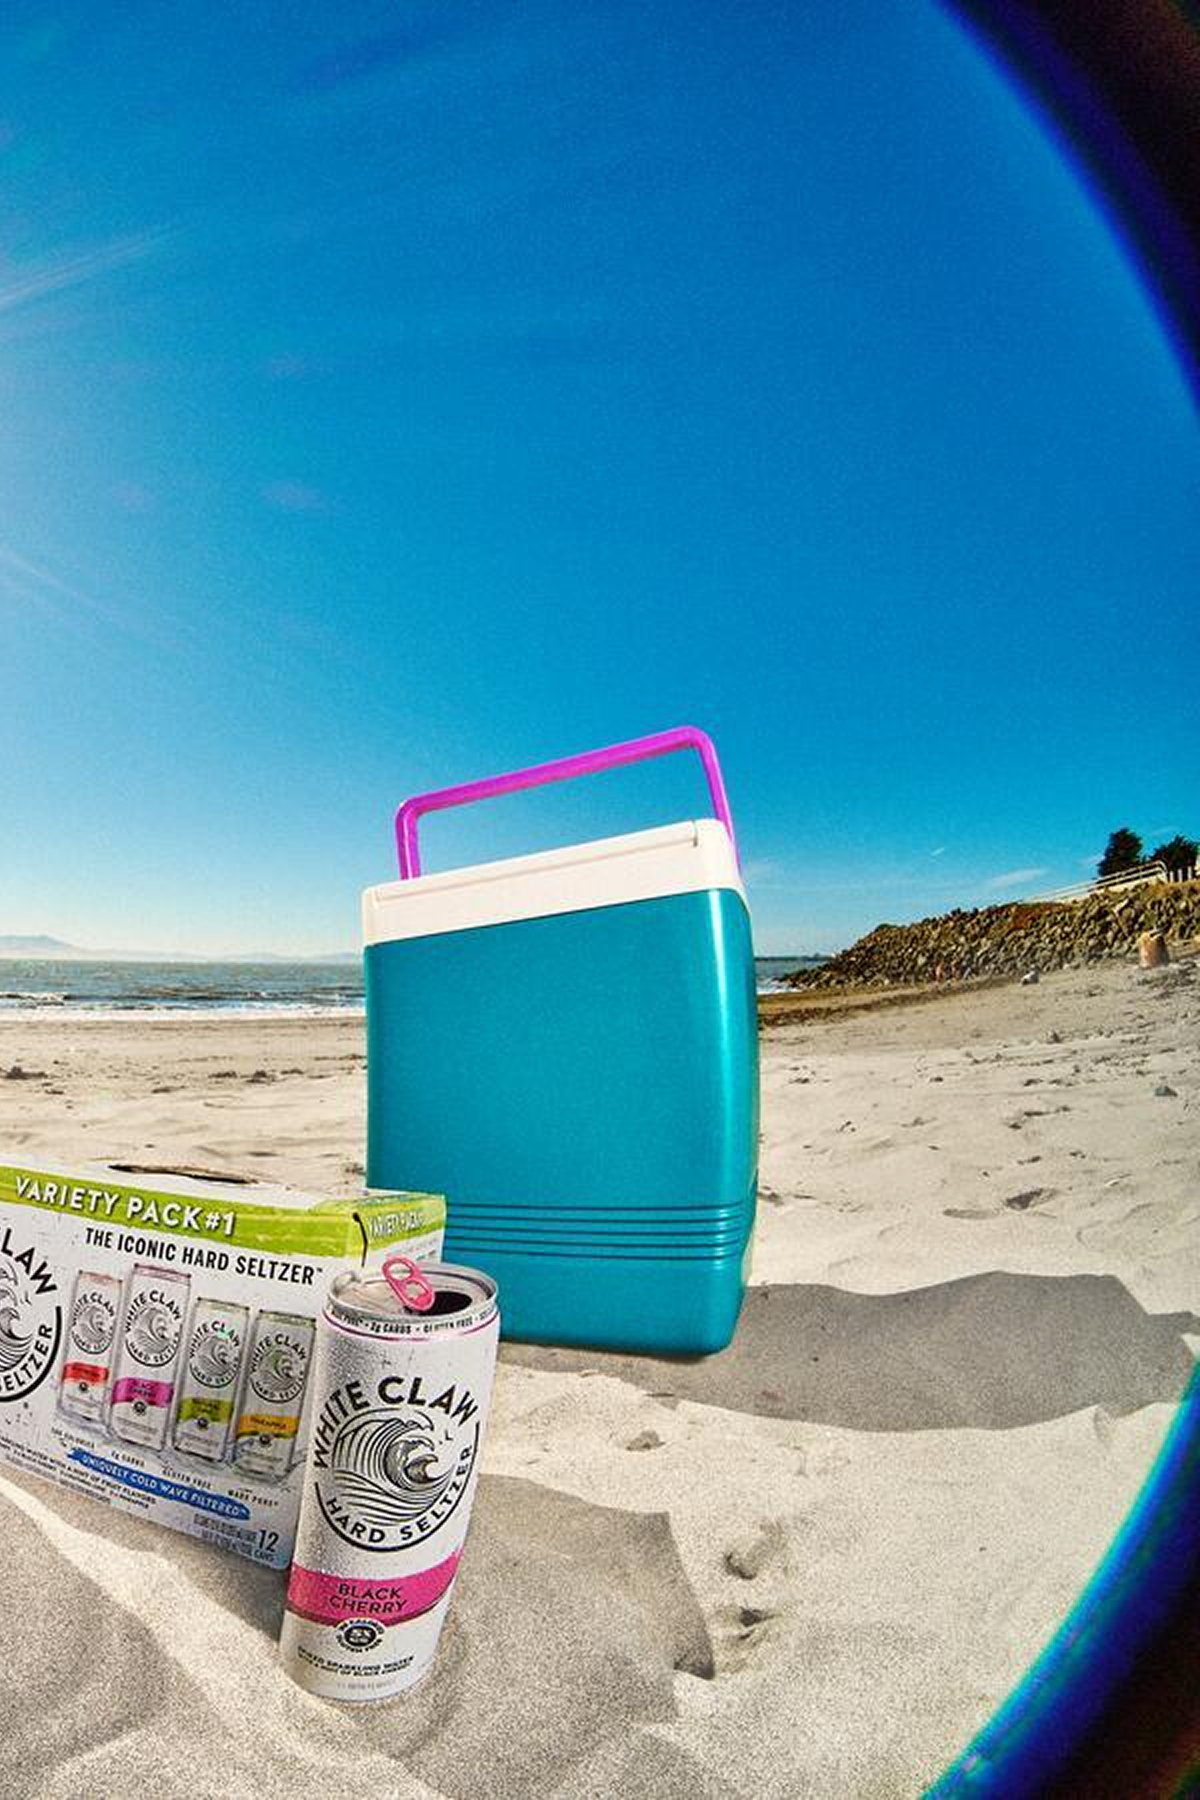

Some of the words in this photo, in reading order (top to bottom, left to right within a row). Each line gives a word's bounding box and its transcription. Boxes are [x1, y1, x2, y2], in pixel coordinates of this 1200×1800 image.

[15, 1176, 120, 1216] VARIETY
[85, 1227, 113, 1249] THE
[116, 1233, 176, 1262] ICONIC
[181, 1247, 229, 1271] HARD
[125, 1292, 149, 1334] WHITE
[150, 1290, 182, 1321] CLAW
[189, 1322, 209, 1360] WHITE
[211, 1320, 240, 1348] CLAW
[251, 1336, 272, 1374] WHITE
[274, 1333, 307, 1362] CLAW
[313, 1380, 370, 1470] WHITE
[377, 1376, 478, 1427] CLAW
[81, 1453, 130, 1480] UNIQUELY
[130, 1471, 158, 1489] COLD
[160, 1483, 188, 1500] WAVE
[325, 1497, 386, 1543] HARD
[400, 1445, 473, 1541] SELTZER
[259, 1529, 279, 1553] 12
[328, 1594, 409, 1614] CHERRY
[337, 1583, 402, 1601] BLACK
